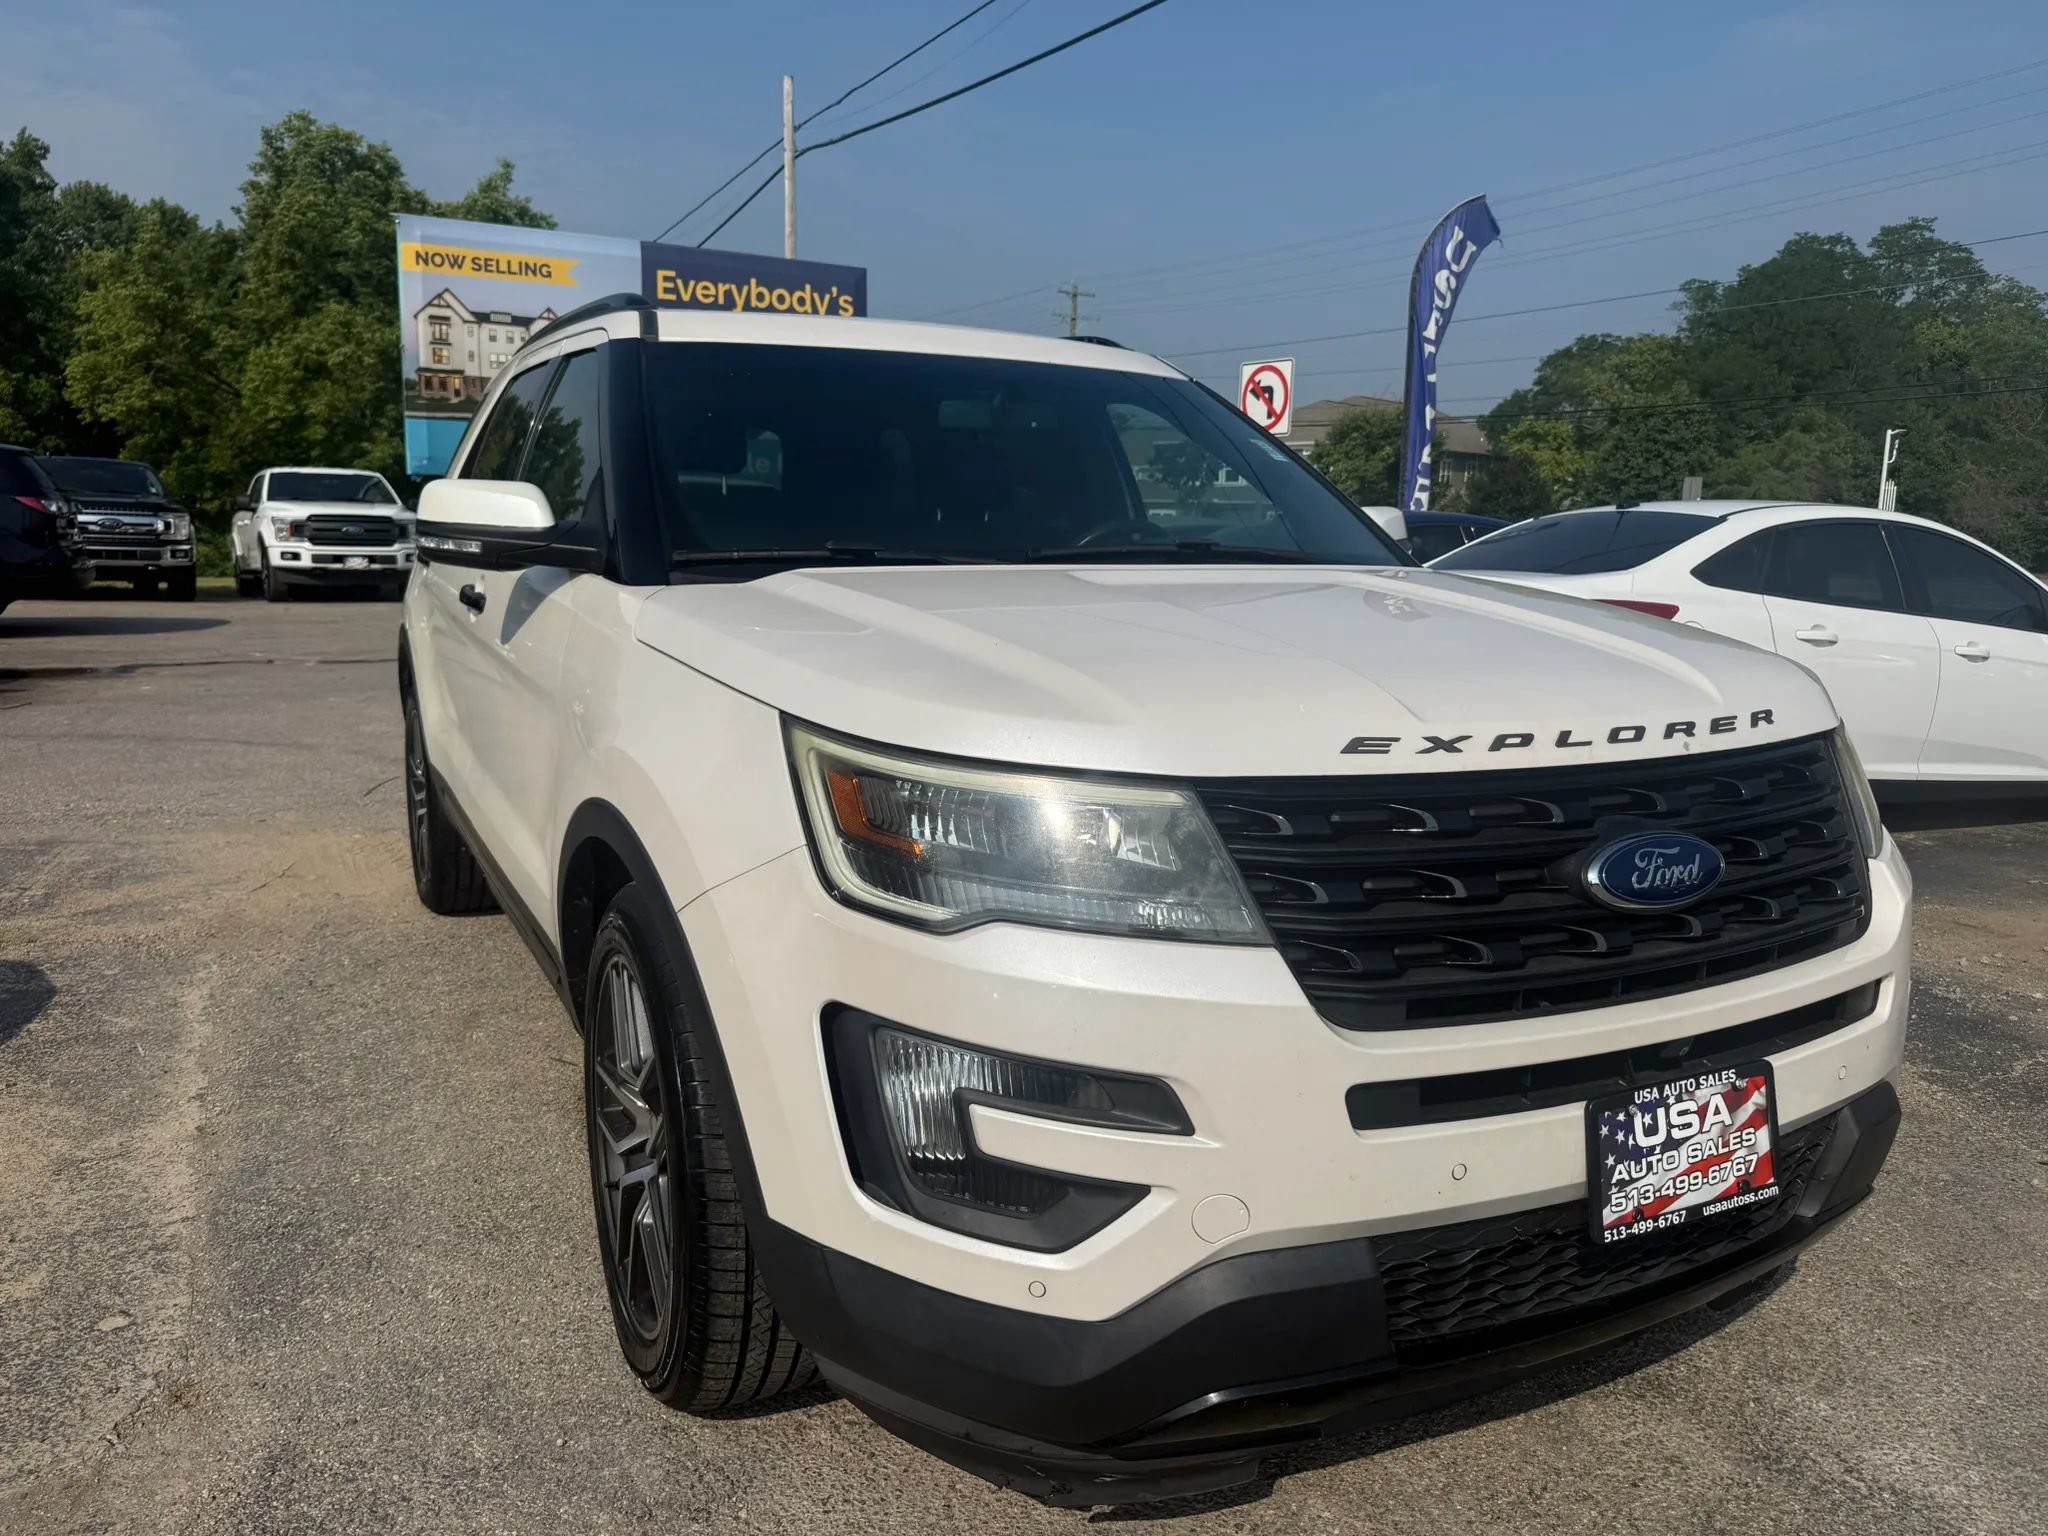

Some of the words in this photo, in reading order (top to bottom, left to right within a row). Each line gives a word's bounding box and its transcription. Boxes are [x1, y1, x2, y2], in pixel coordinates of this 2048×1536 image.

[414, 249, 467, 271] NOW
[470, 256, 553, 280] SELLING
[656, 269, 855, 318] Everybody's
[1340, 708, 1776, 755] EXPLORER
[1631, 846, 1704, 890] Ford
[1634, 1088, 1660, 1105] USA
[1663, 1078, 1696, 1097] AUTO
[1699, 1069, 1737, 1090] SALES
[1633, 1093, 1733, 1149] USA
[1611, 1149, 1680, 1184] AUTO
[1687, 1127, 1757, 1164] SALES
[1610, 1153, 1760, 1214] 513-499-6767
[1603, 1210, 1688, 1244] 513-499-6767
[1702, 1185, 1780, 1217] usaautoss.com
